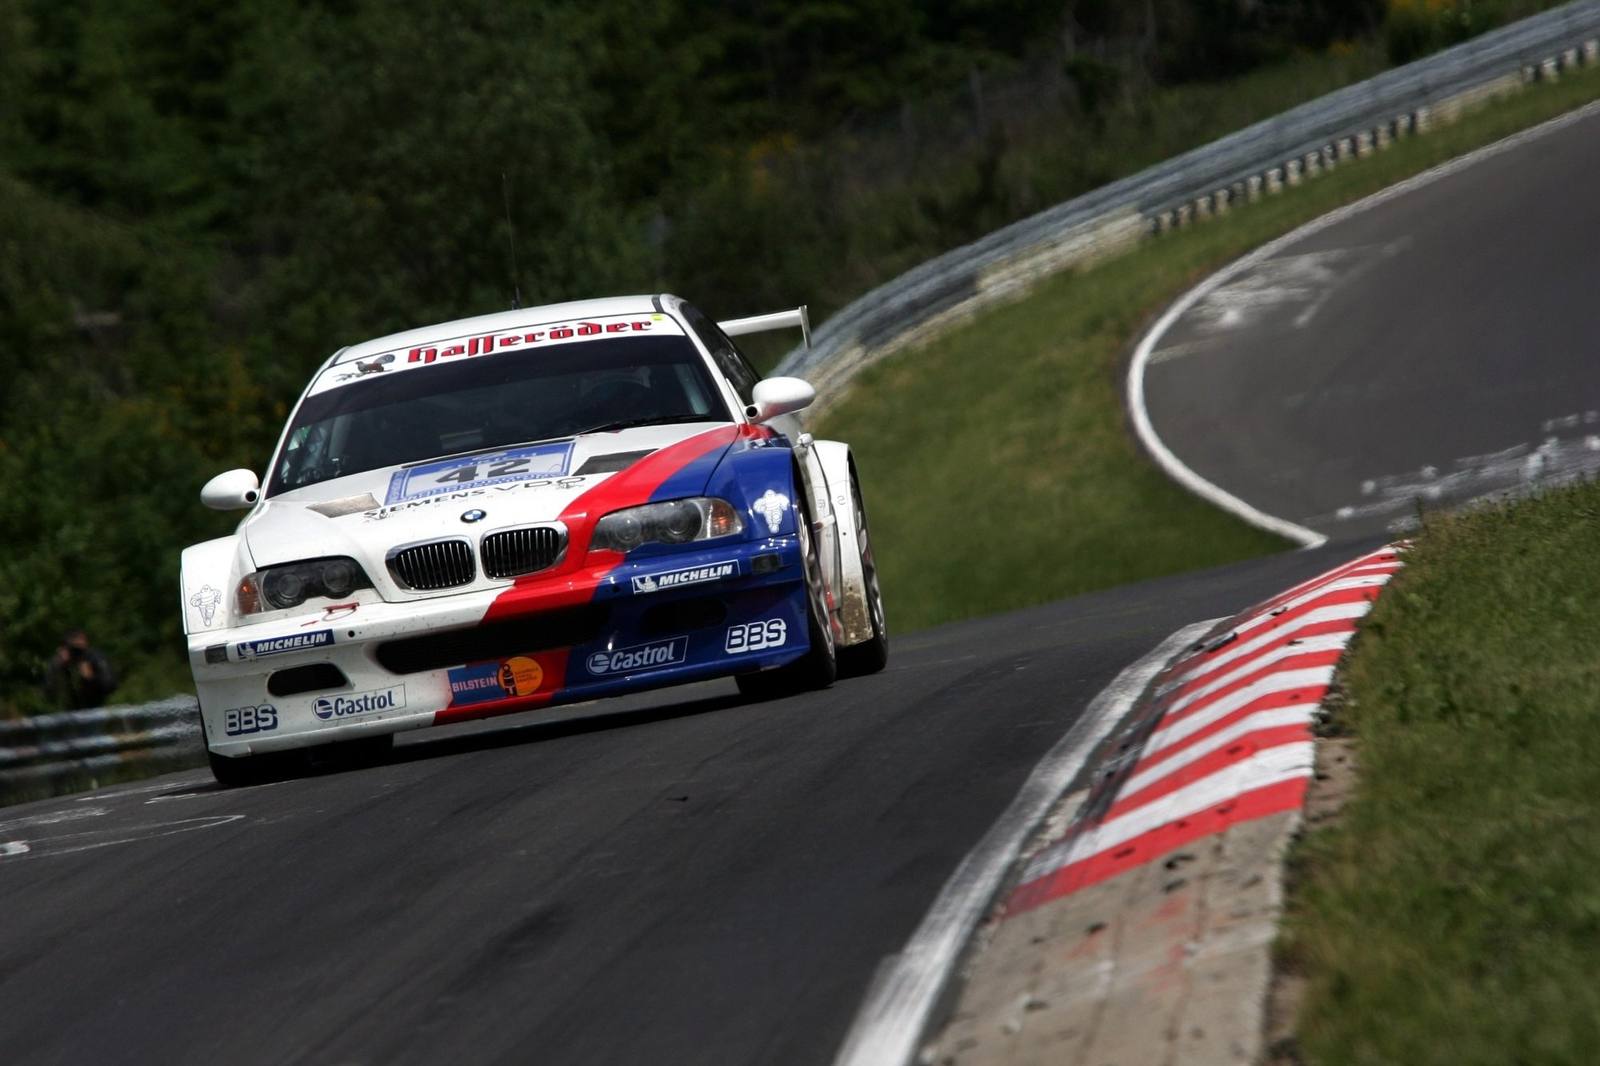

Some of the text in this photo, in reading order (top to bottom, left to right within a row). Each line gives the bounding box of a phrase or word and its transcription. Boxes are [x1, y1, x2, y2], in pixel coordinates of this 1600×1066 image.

[435, 459, 532, 483] 42
[658, 565, 733, 586] MICHELIN
[256, 632, 328, 653] MICHELIN
[725, 618, 787, 654] BBS
[610, 641, 674, 671] Castrol
[451, 676, 498, 693] BILSTEIN
[333, 691, 396, 716] Castrol
[225, 704, 278, 736] BBS
